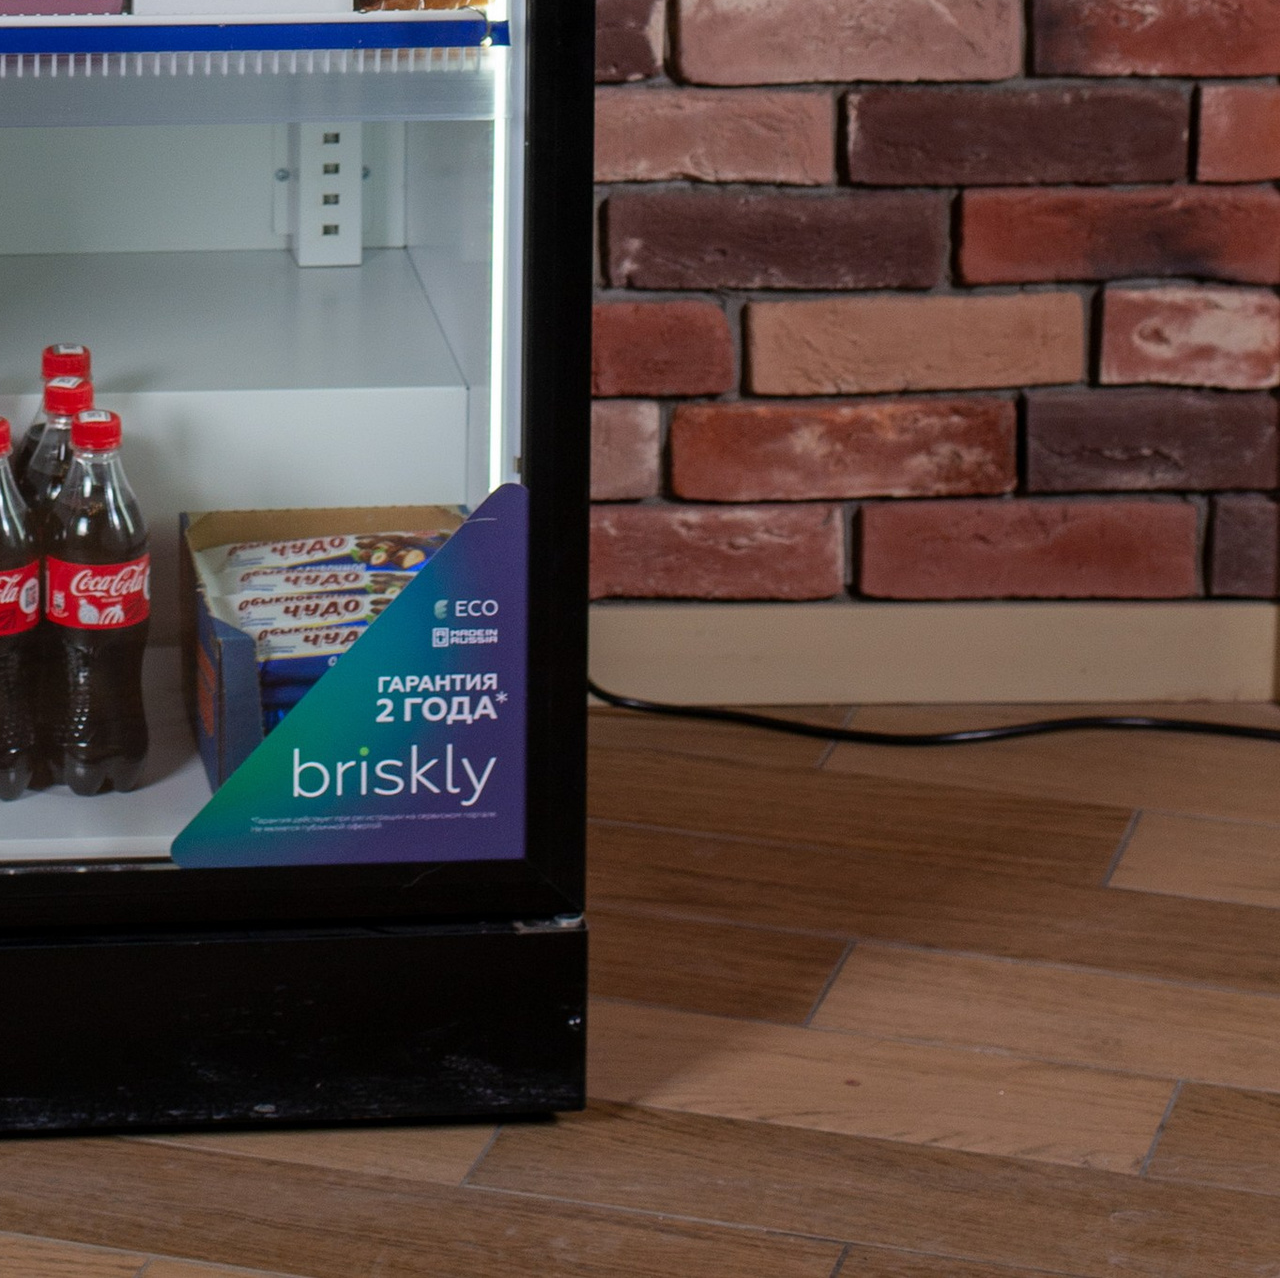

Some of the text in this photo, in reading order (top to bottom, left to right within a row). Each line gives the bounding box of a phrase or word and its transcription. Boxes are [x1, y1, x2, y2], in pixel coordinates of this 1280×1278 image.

[271, 536, 347, 557] ЧУДО
[70, 562, 146, 597] Coca-Cola
[284, 572, 361, 586] ЧУДО
[283, 599, 362, 618] ЧУДО
[455, 599, 499, 617] ECO
[449, 636, 499, 645] RUSSIA
[377, 673, 498, 694] ГАРАНТИЯ
[375, 698, 395, 723] 2
[293, 743, 497, 807] briskly
